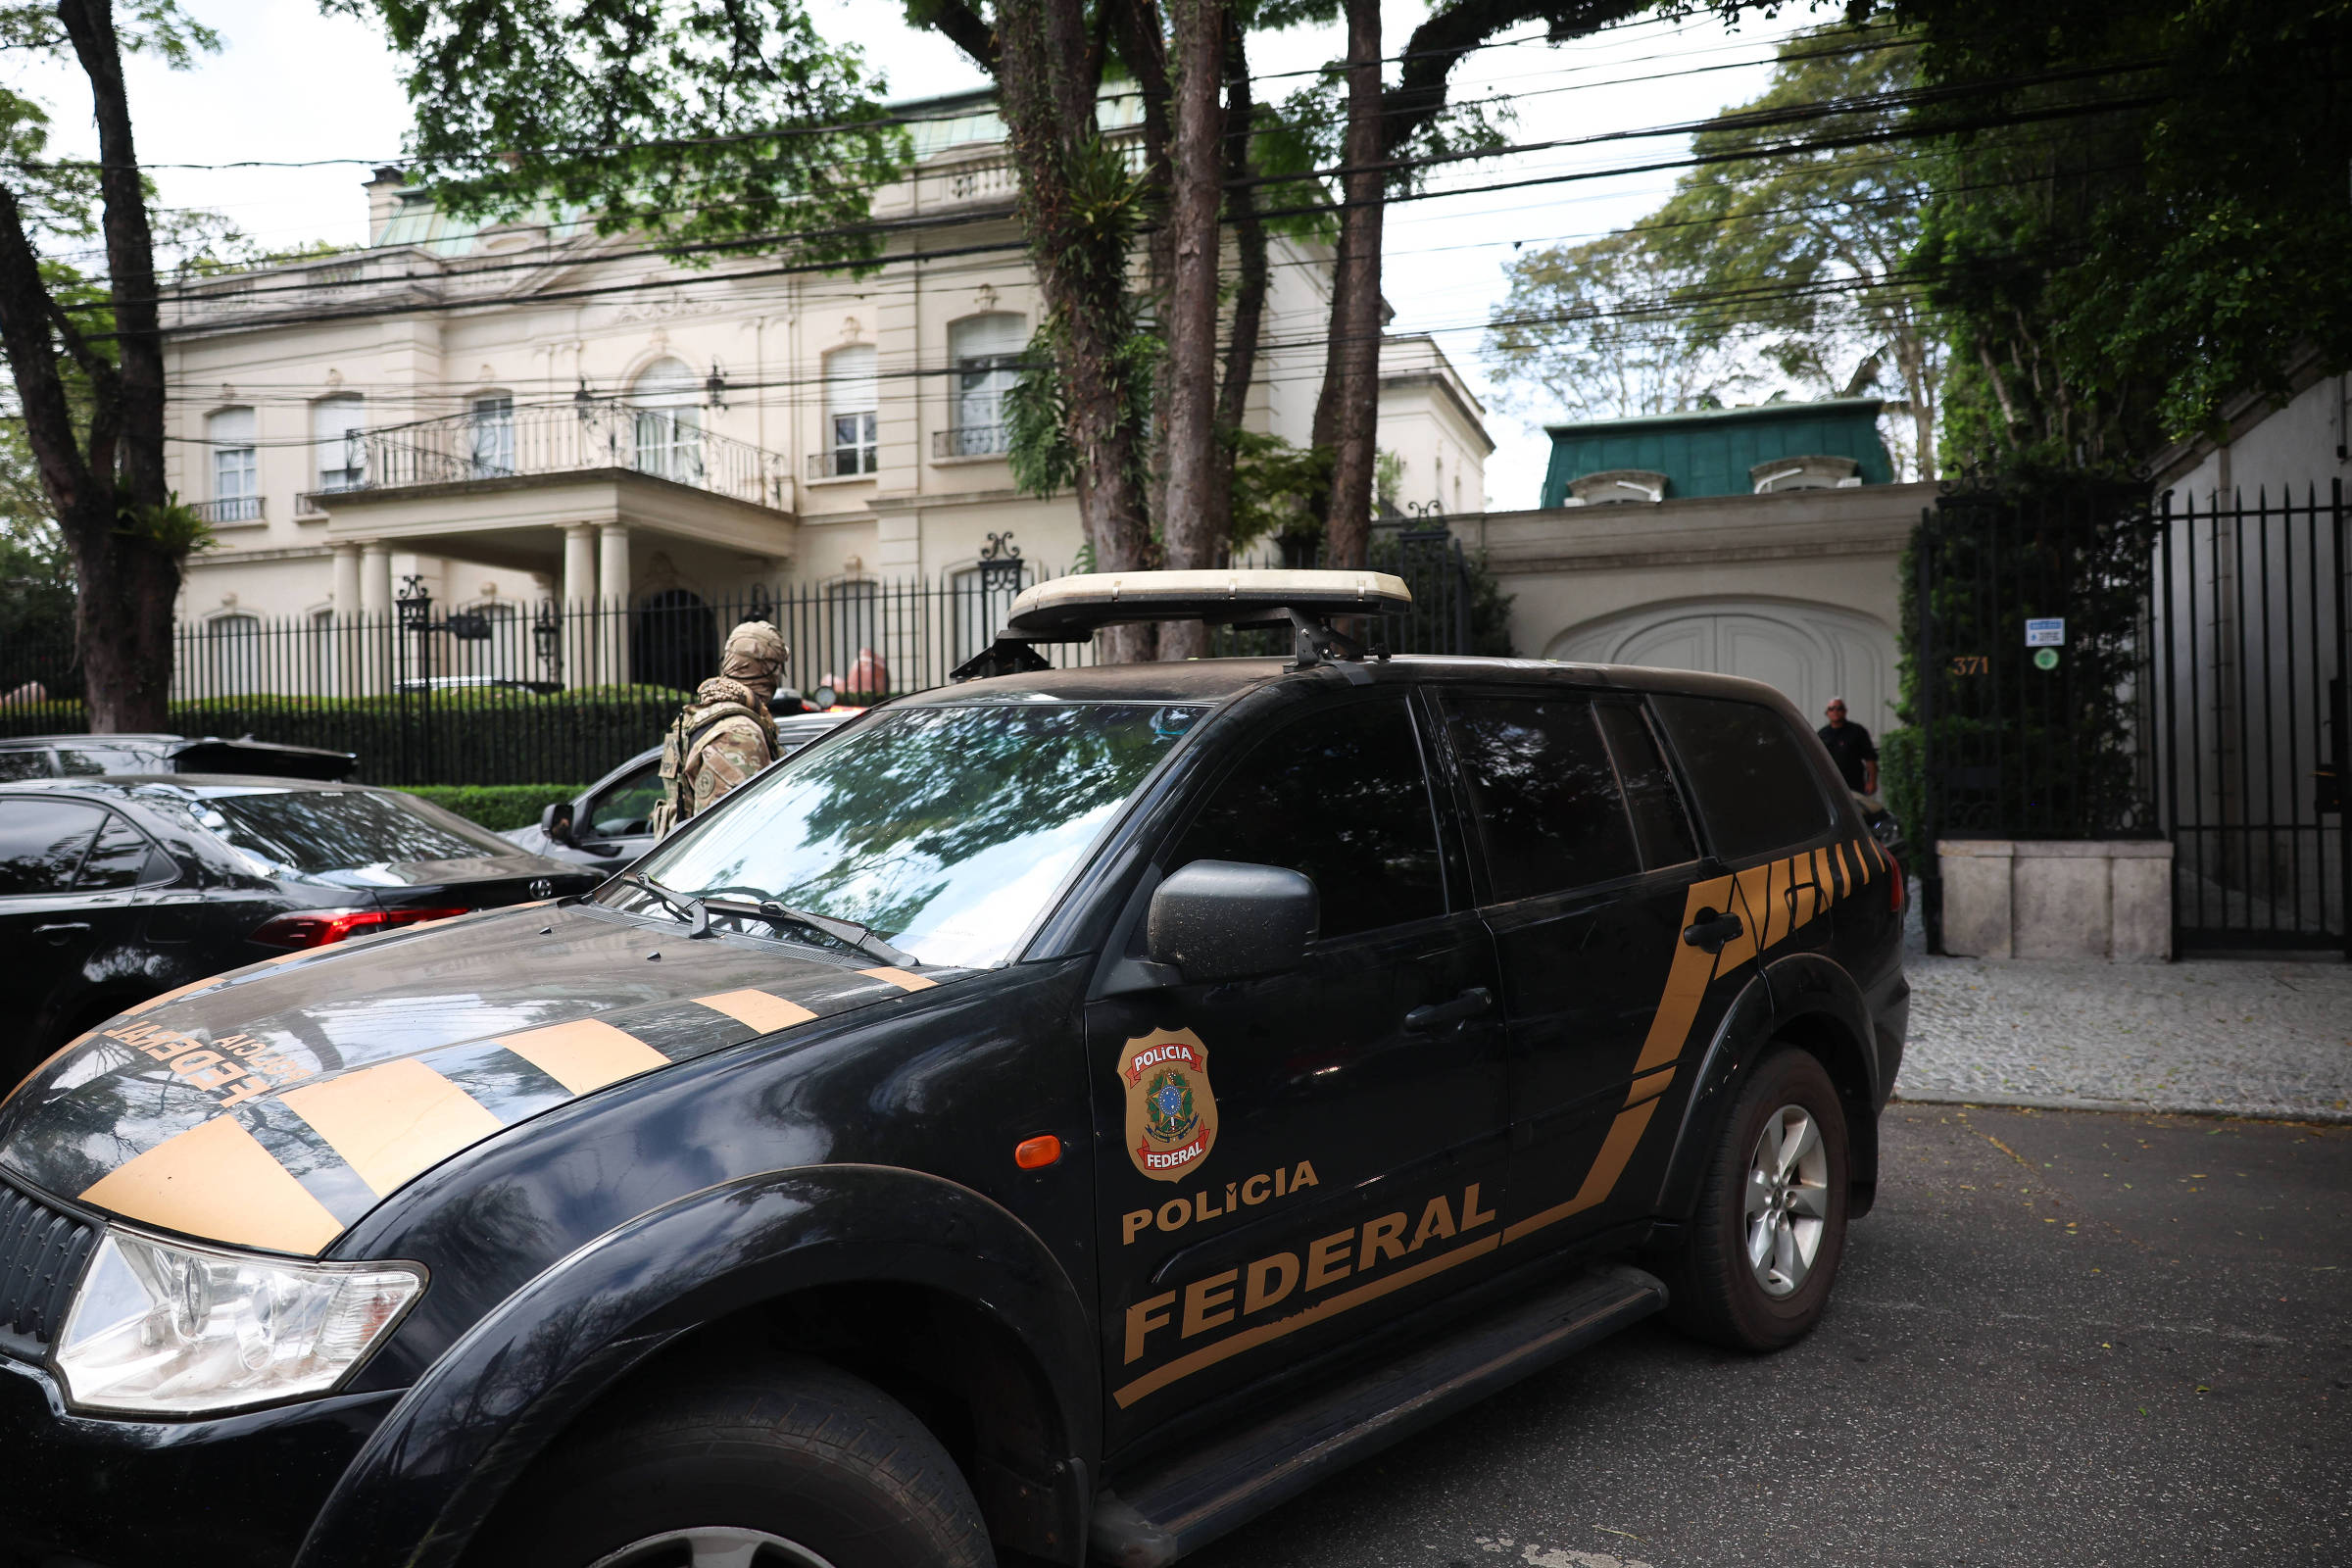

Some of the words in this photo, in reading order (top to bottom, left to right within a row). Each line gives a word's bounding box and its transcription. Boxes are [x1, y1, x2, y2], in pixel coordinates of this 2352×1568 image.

[1952, 657, 1989, 675] 371
[1147, 1142, 1203, 1168] FEDERAL
[1124, 1182, 1495, 1365] FEDERAL
